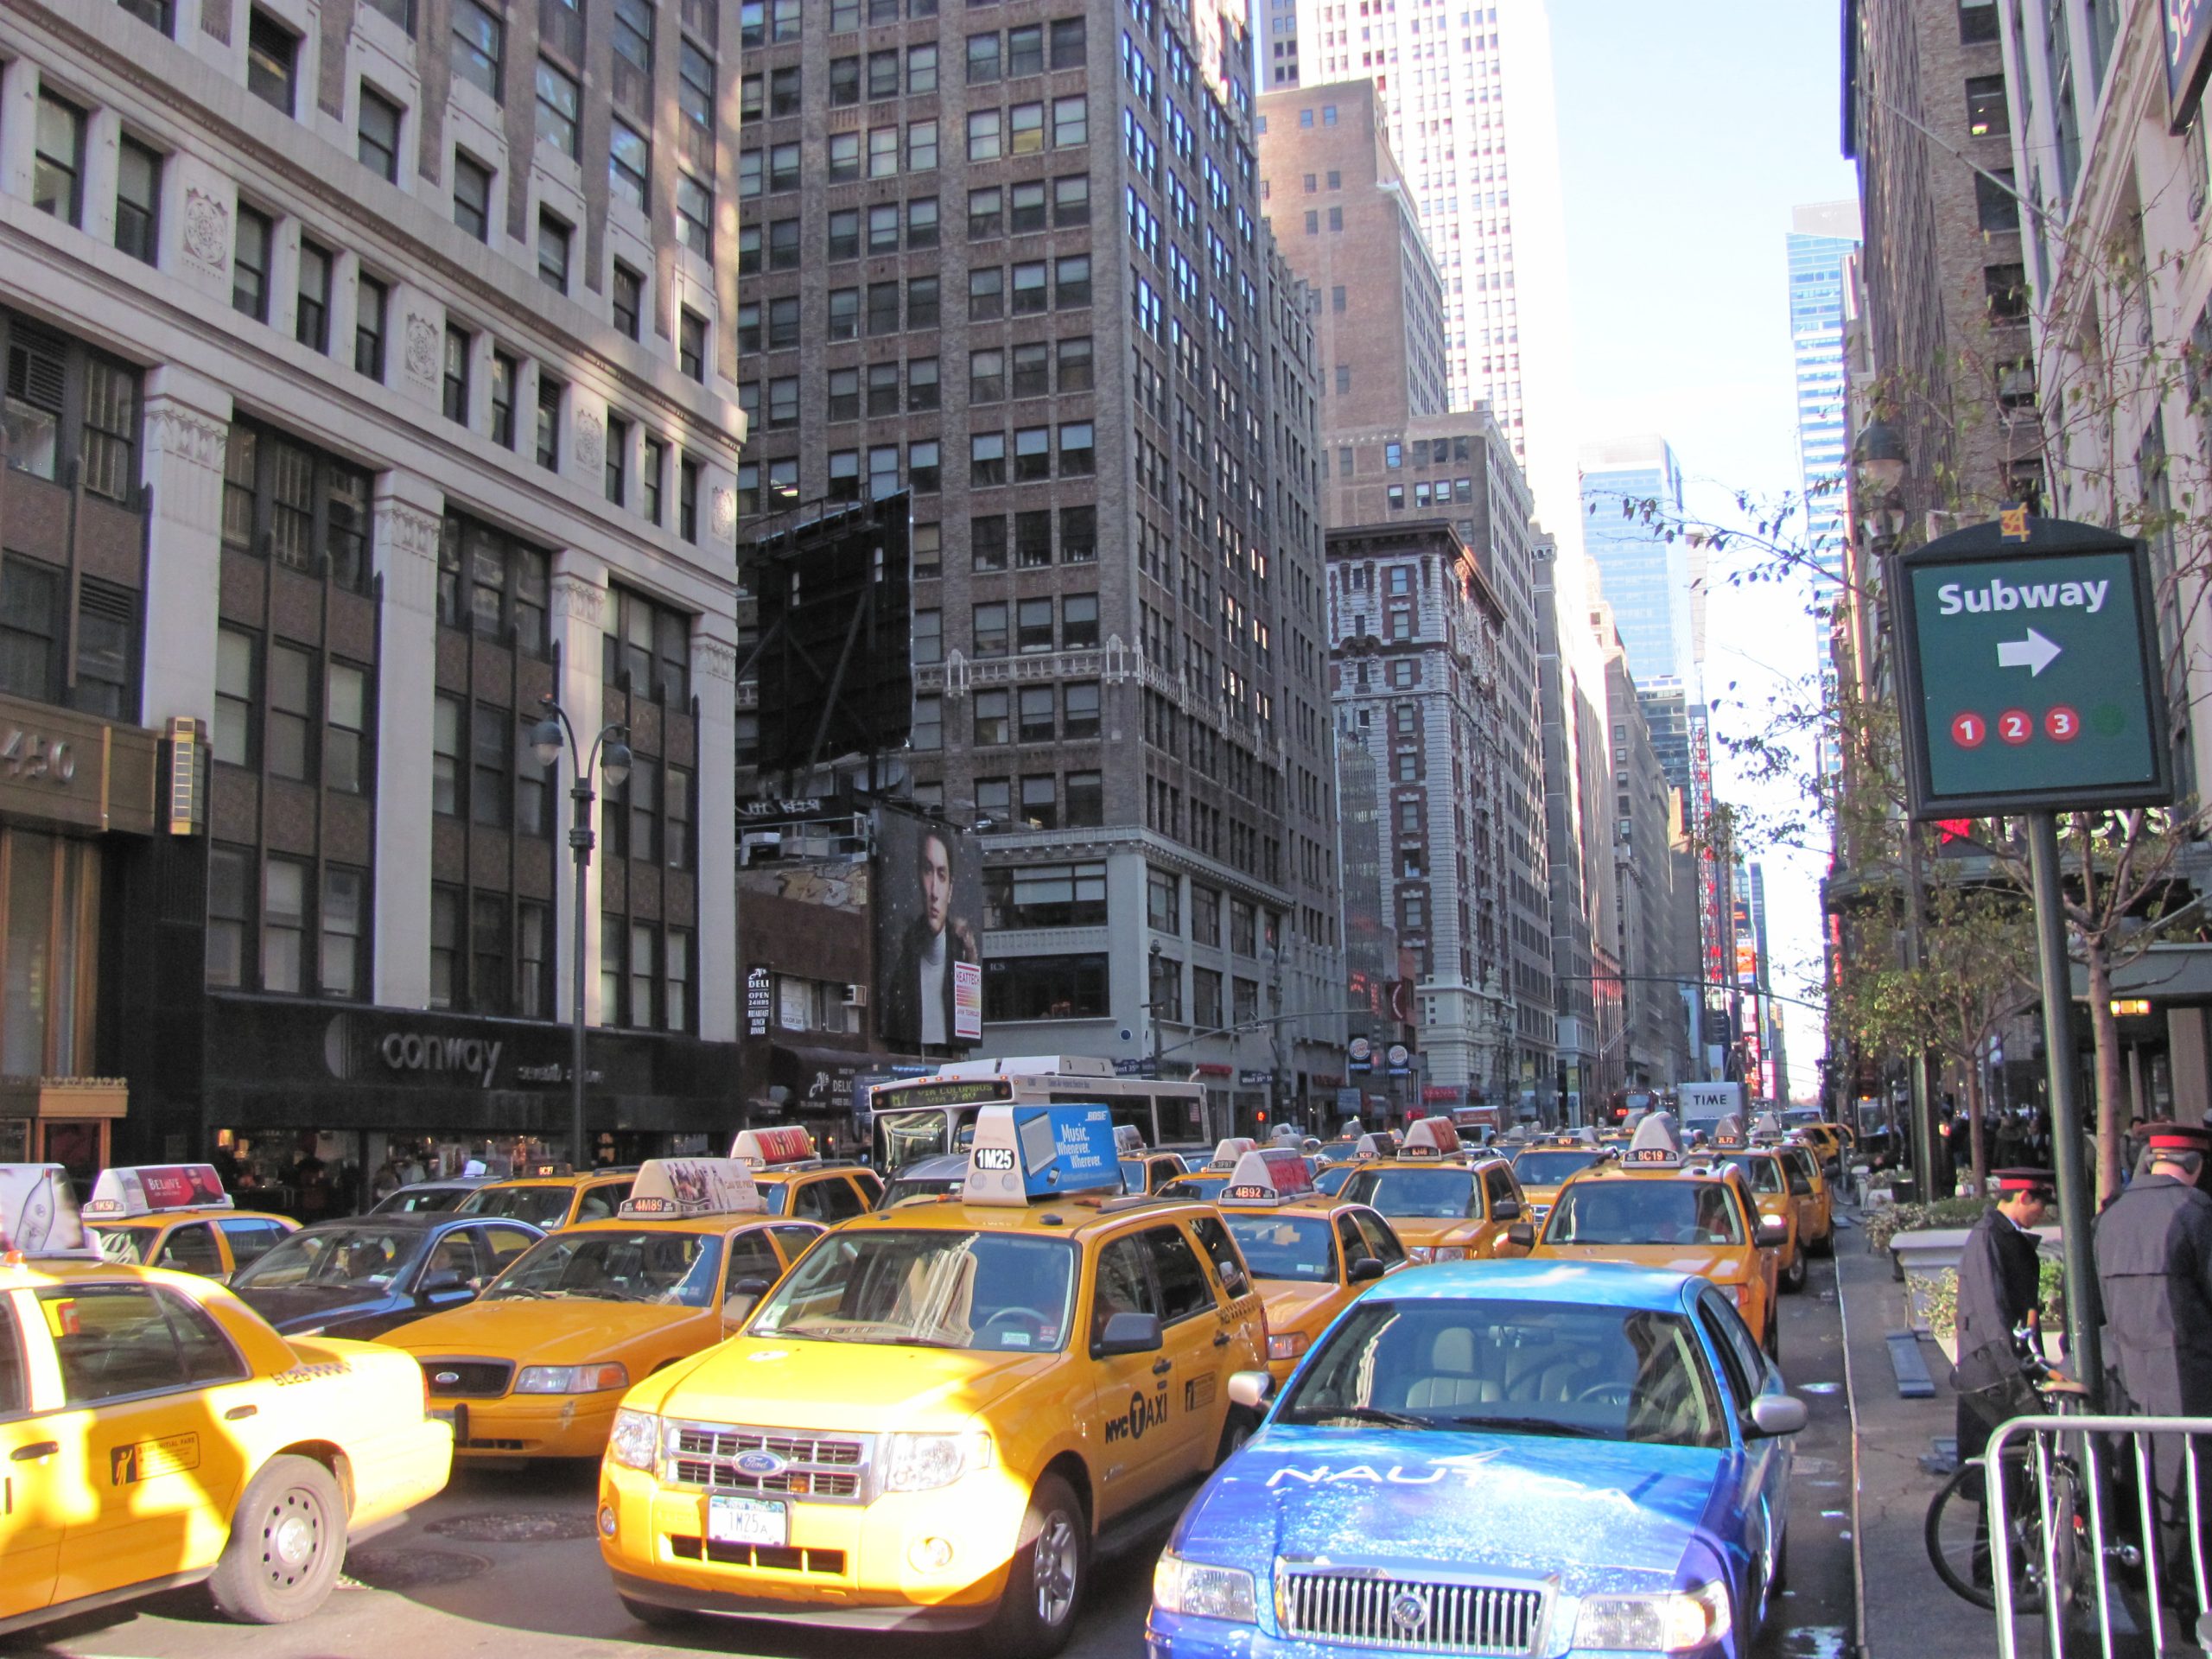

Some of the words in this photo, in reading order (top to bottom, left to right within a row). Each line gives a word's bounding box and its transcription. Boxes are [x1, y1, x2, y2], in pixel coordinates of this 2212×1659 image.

[1938, 579, 2109, 615] Subway
[1961, 721, 1974, 741] 1
[2007, 717, 2023, 737] 2
[2054, 714, 2069, 734] 3
[748, 979, 770, 988] DELI
[383, 1033, 503, 1088] conway
[1694, 1094, 1727, 1106] TIME
[1085, 1110, 1108, 1122] BOSE
[1061, 1124, 1090, 1142] Music.
[1056, 1141, 1090, 1156] Whenever.
[977, 1149, 1013, 1169] 1M25
[1071, 1155, 1103, 1169] Wherever.
[1638, 1150, 1663, 1161] 8C19
[1236, 1186, 1261, 1198] 4B92
[95, 1201, 114, 1211] 1K50
[635, 1199, 663, 1211] 4M89
[1105, 1415, 1129, 1445] NYC
[1130, 1390, 1167, 1440] TAXI
[745, 1457, 768, 1469] Ford
